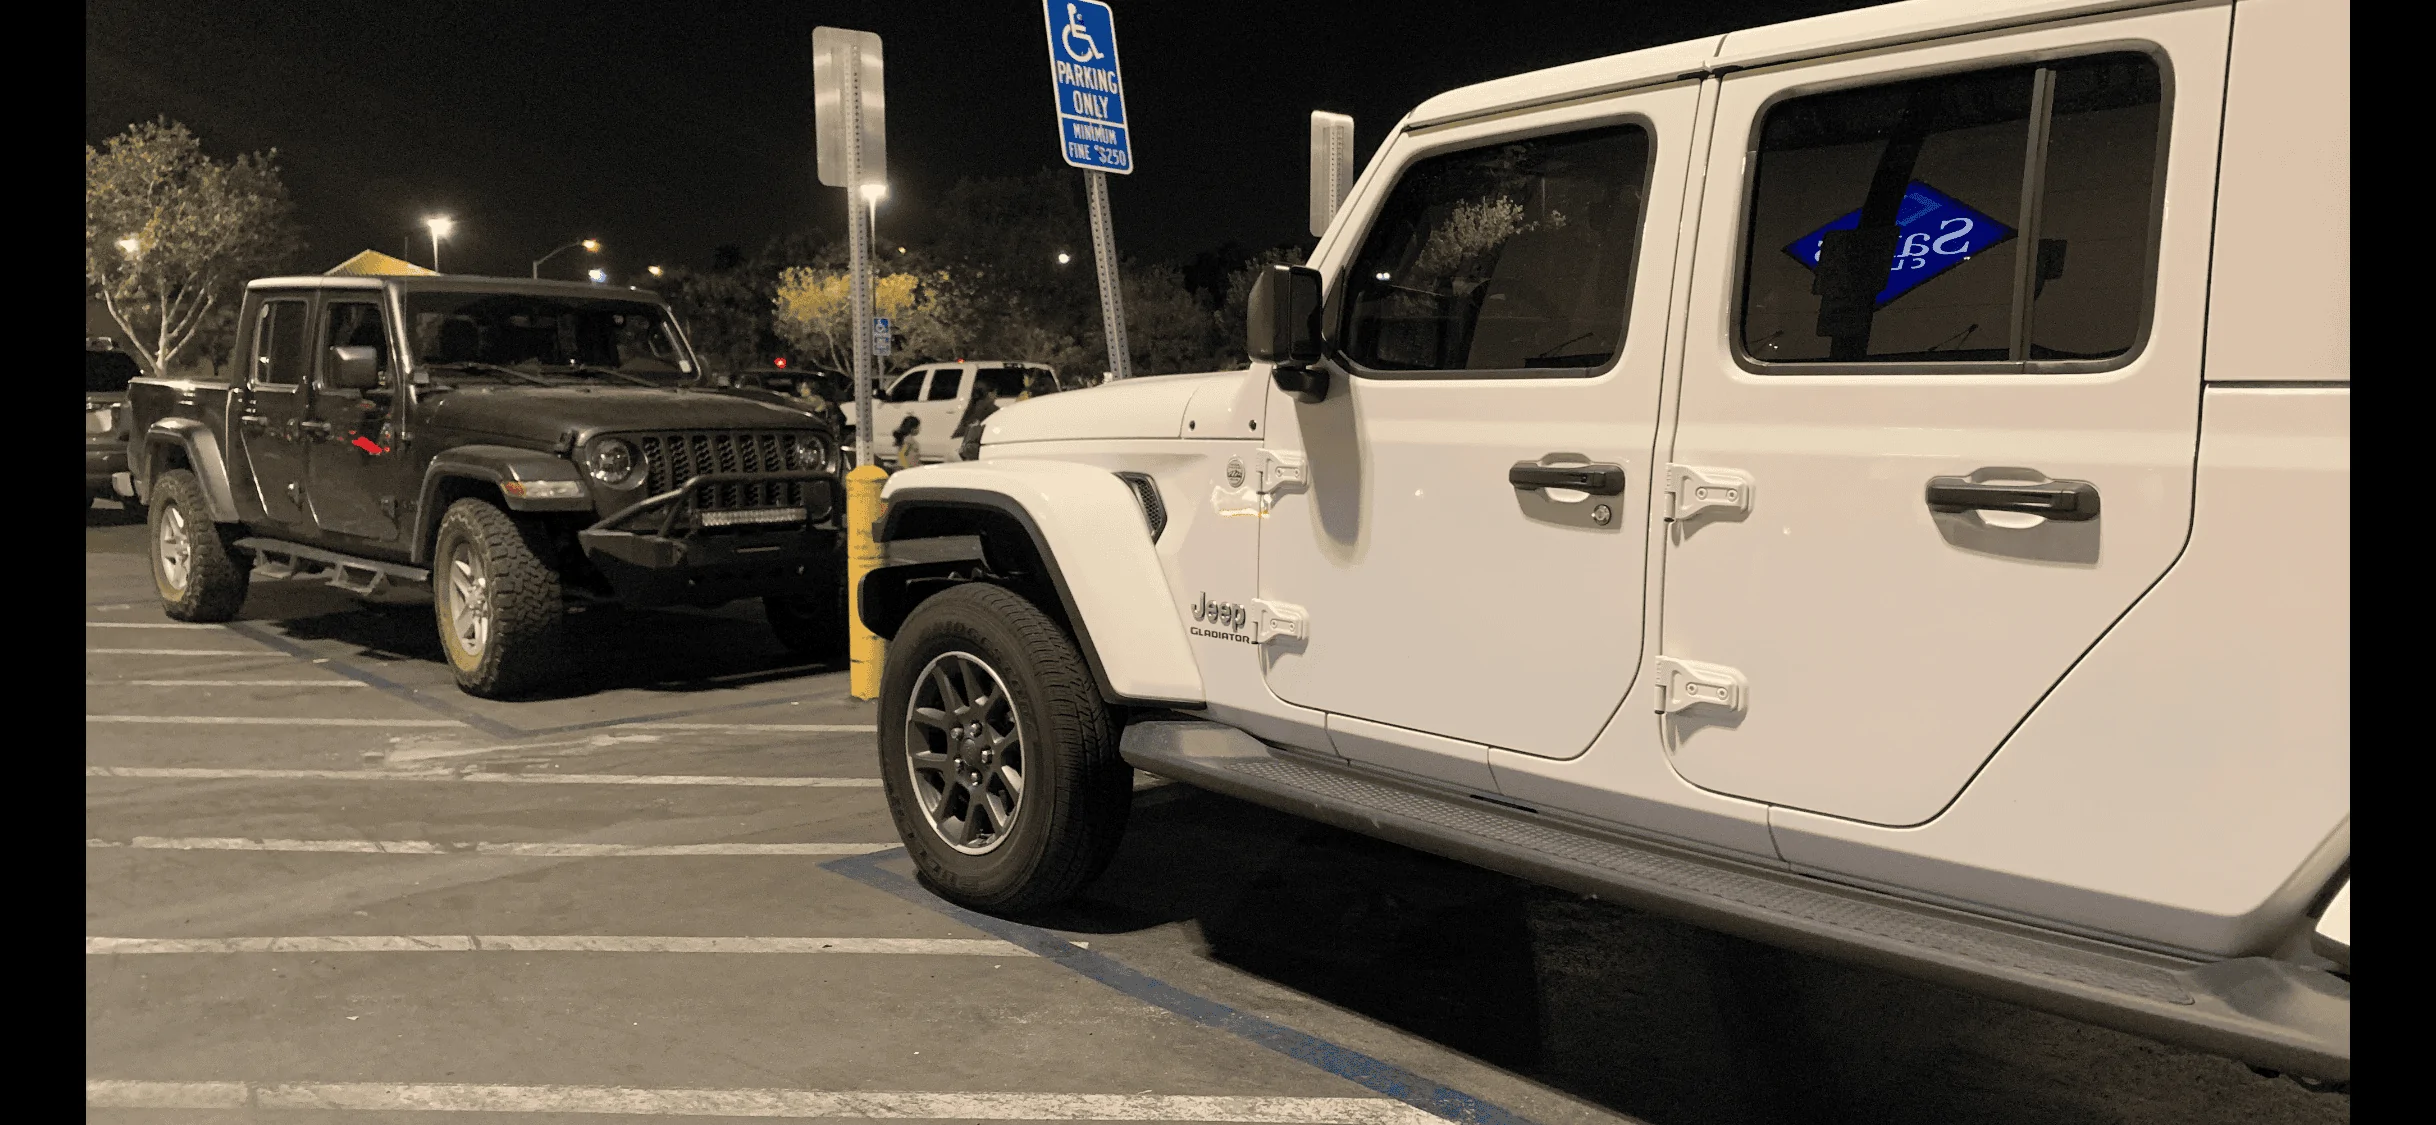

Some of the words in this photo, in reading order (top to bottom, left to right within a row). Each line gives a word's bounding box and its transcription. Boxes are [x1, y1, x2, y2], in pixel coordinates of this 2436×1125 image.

[1057, 61, 1118, 94] PARKING
[1073, 91, 1109, 119] ONLY
[1073, 123, 1117, 145] MINIMUM
[1068, 142, 1091, 161] FINE
[1095, 146, 1127, 167] $250
[1191, 591, 1246, 633] Jeep
[1190, 627, 1250, 644] GLADIATOR
